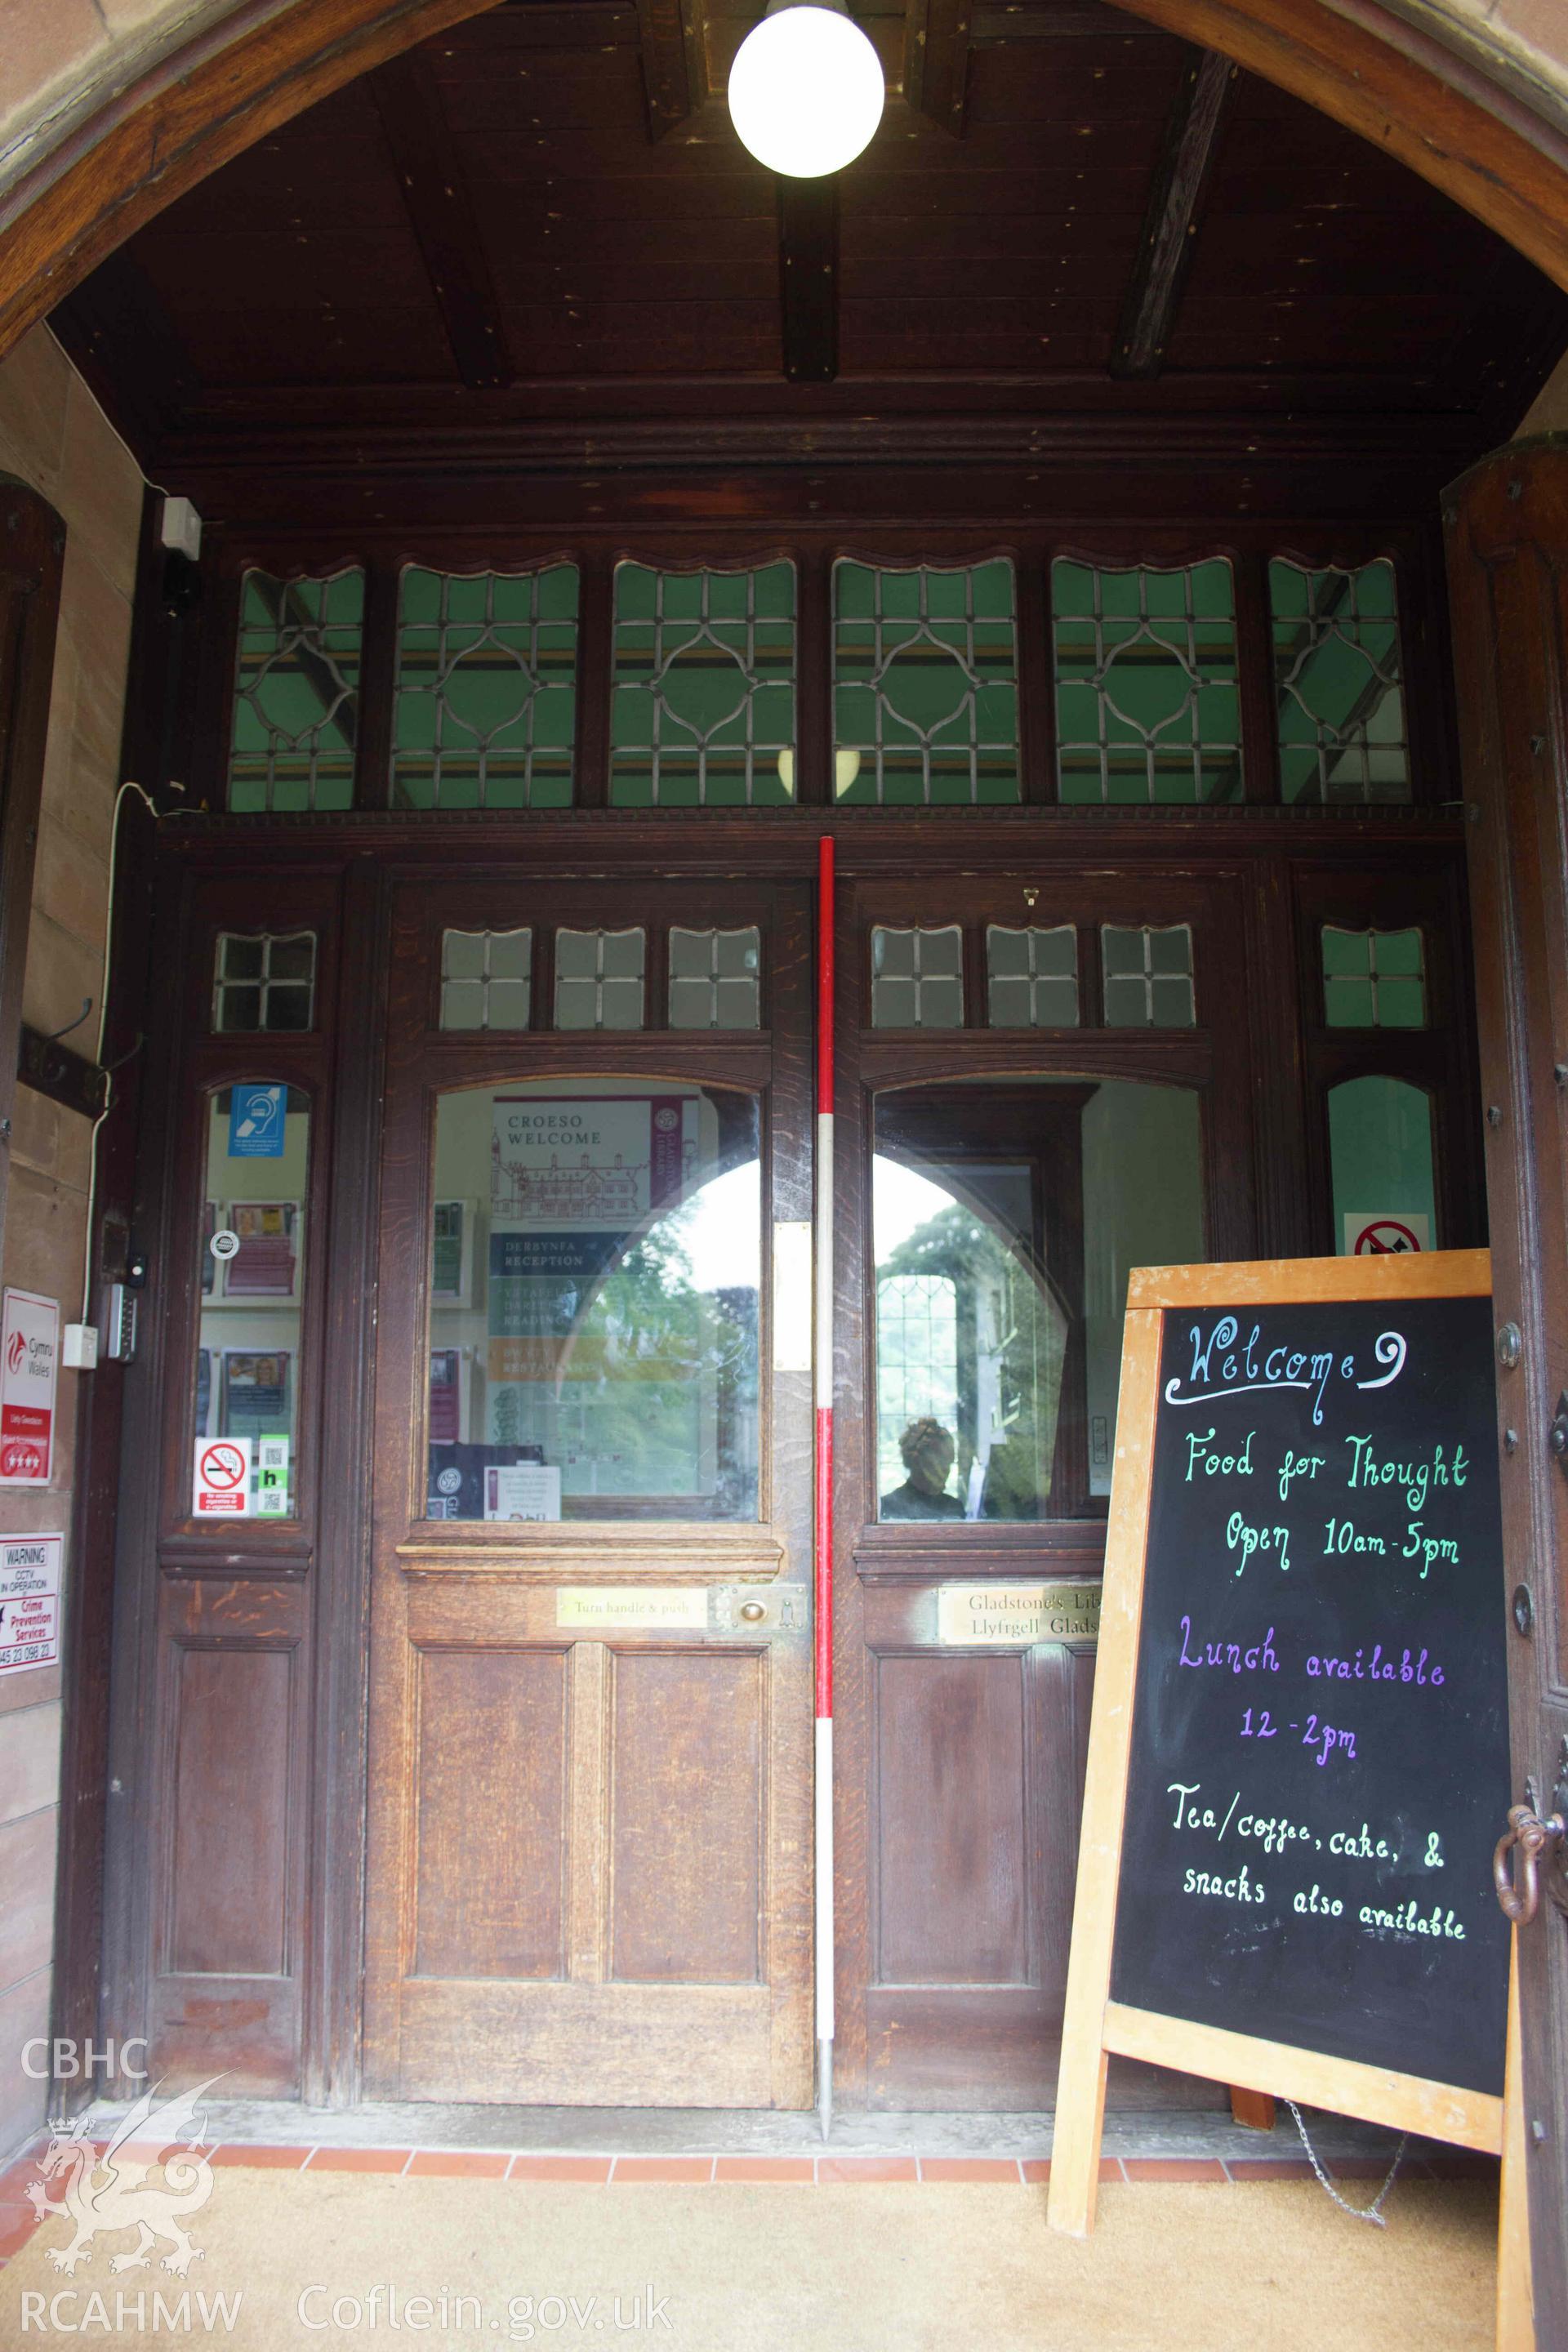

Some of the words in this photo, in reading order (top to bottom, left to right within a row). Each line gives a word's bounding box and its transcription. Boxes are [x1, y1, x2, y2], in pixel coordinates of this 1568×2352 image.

[508, 1116, 582, 1128] CROESO
[508, 1132, 601, 1144] WELCOME
[505, 1256, 583, 1266] RECEPTION
[29, 1338, 52, 1359] Cymru
[28, 1361, 50, 1378] Wales
[1189, 1316, 1354, 1425] Welcome
[1185, 1428, 1256, 1482] Food
[1278, 1450, 1325, 1501] for
[1345, 1434, 1469, 1512] Thought
[1227, 1512, 1290, 1577] Open
[7, 1547, 45, 1565] WARNING
[15, 1570, 34, 1580] CCTV
[1, 1583, 8, 1592] IN
[10, 1579, 47, 1592] OPERATION
[21, 1601, 43, 1613] Crime
[575, 1601, 602, 1613] Turn
[607, 1601, 644, 1614] handle
[648, 1604, 656, 1613] &
[662, 1602, 689, 1617] push
[969, 1594, 1063, 1610] Gladstone's
[11, 1613, 51, 1628] Prevention
[973, 1619, 1039, 1638] Llyfrgell
[16, 1628, 47, 1642] Services
[1179, 1615, 1280, 1673] Lunch
[1307, 1644, 1445, 1686] available
[1330, 1823, 1398, 1862] cake,
[1424, 1832, 1445, 1868] &
[1183, 1865, 1266, 1904] snacks
[1294, 1884, 1344, 1917] also
[1359, 1900, 1467, 1940] available
